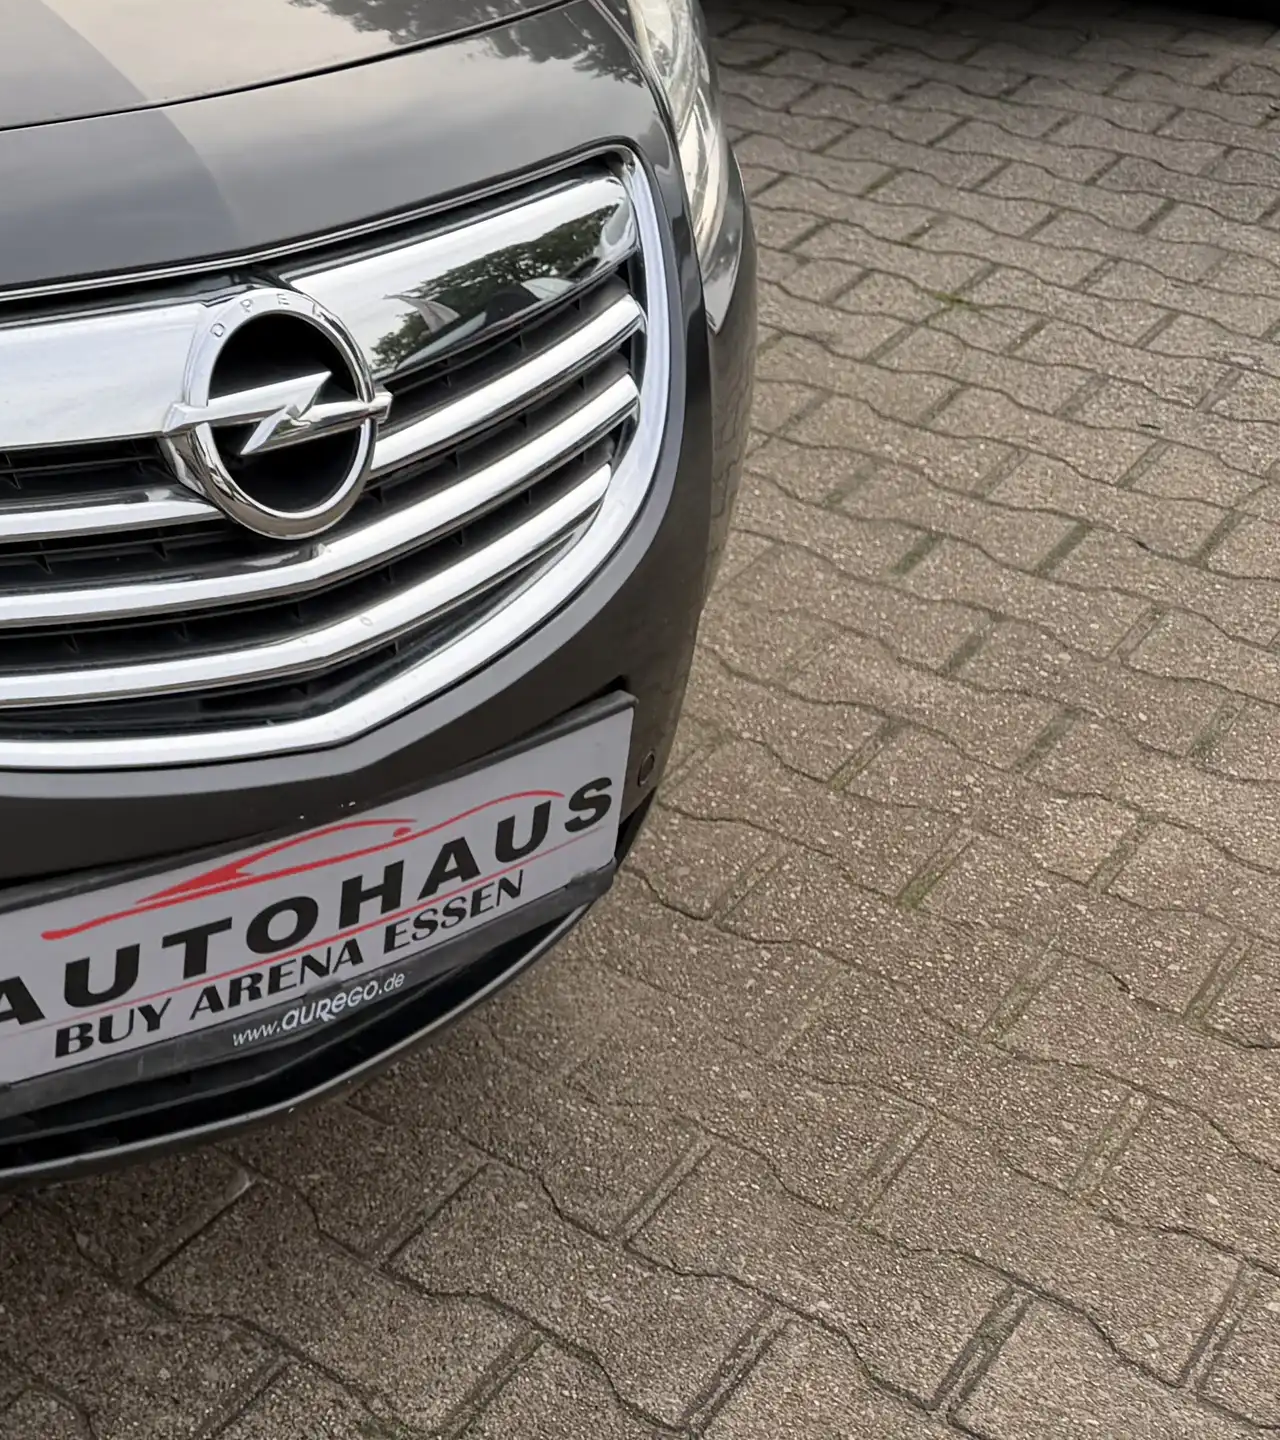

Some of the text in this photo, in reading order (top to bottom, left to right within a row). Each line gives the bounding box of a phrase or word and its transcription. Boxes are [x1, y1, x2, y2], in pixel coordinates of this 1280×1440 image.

[209, 293, 322, 338] OPEL
[55, 869, 523, 1058] BUY ARENA ESSEN
